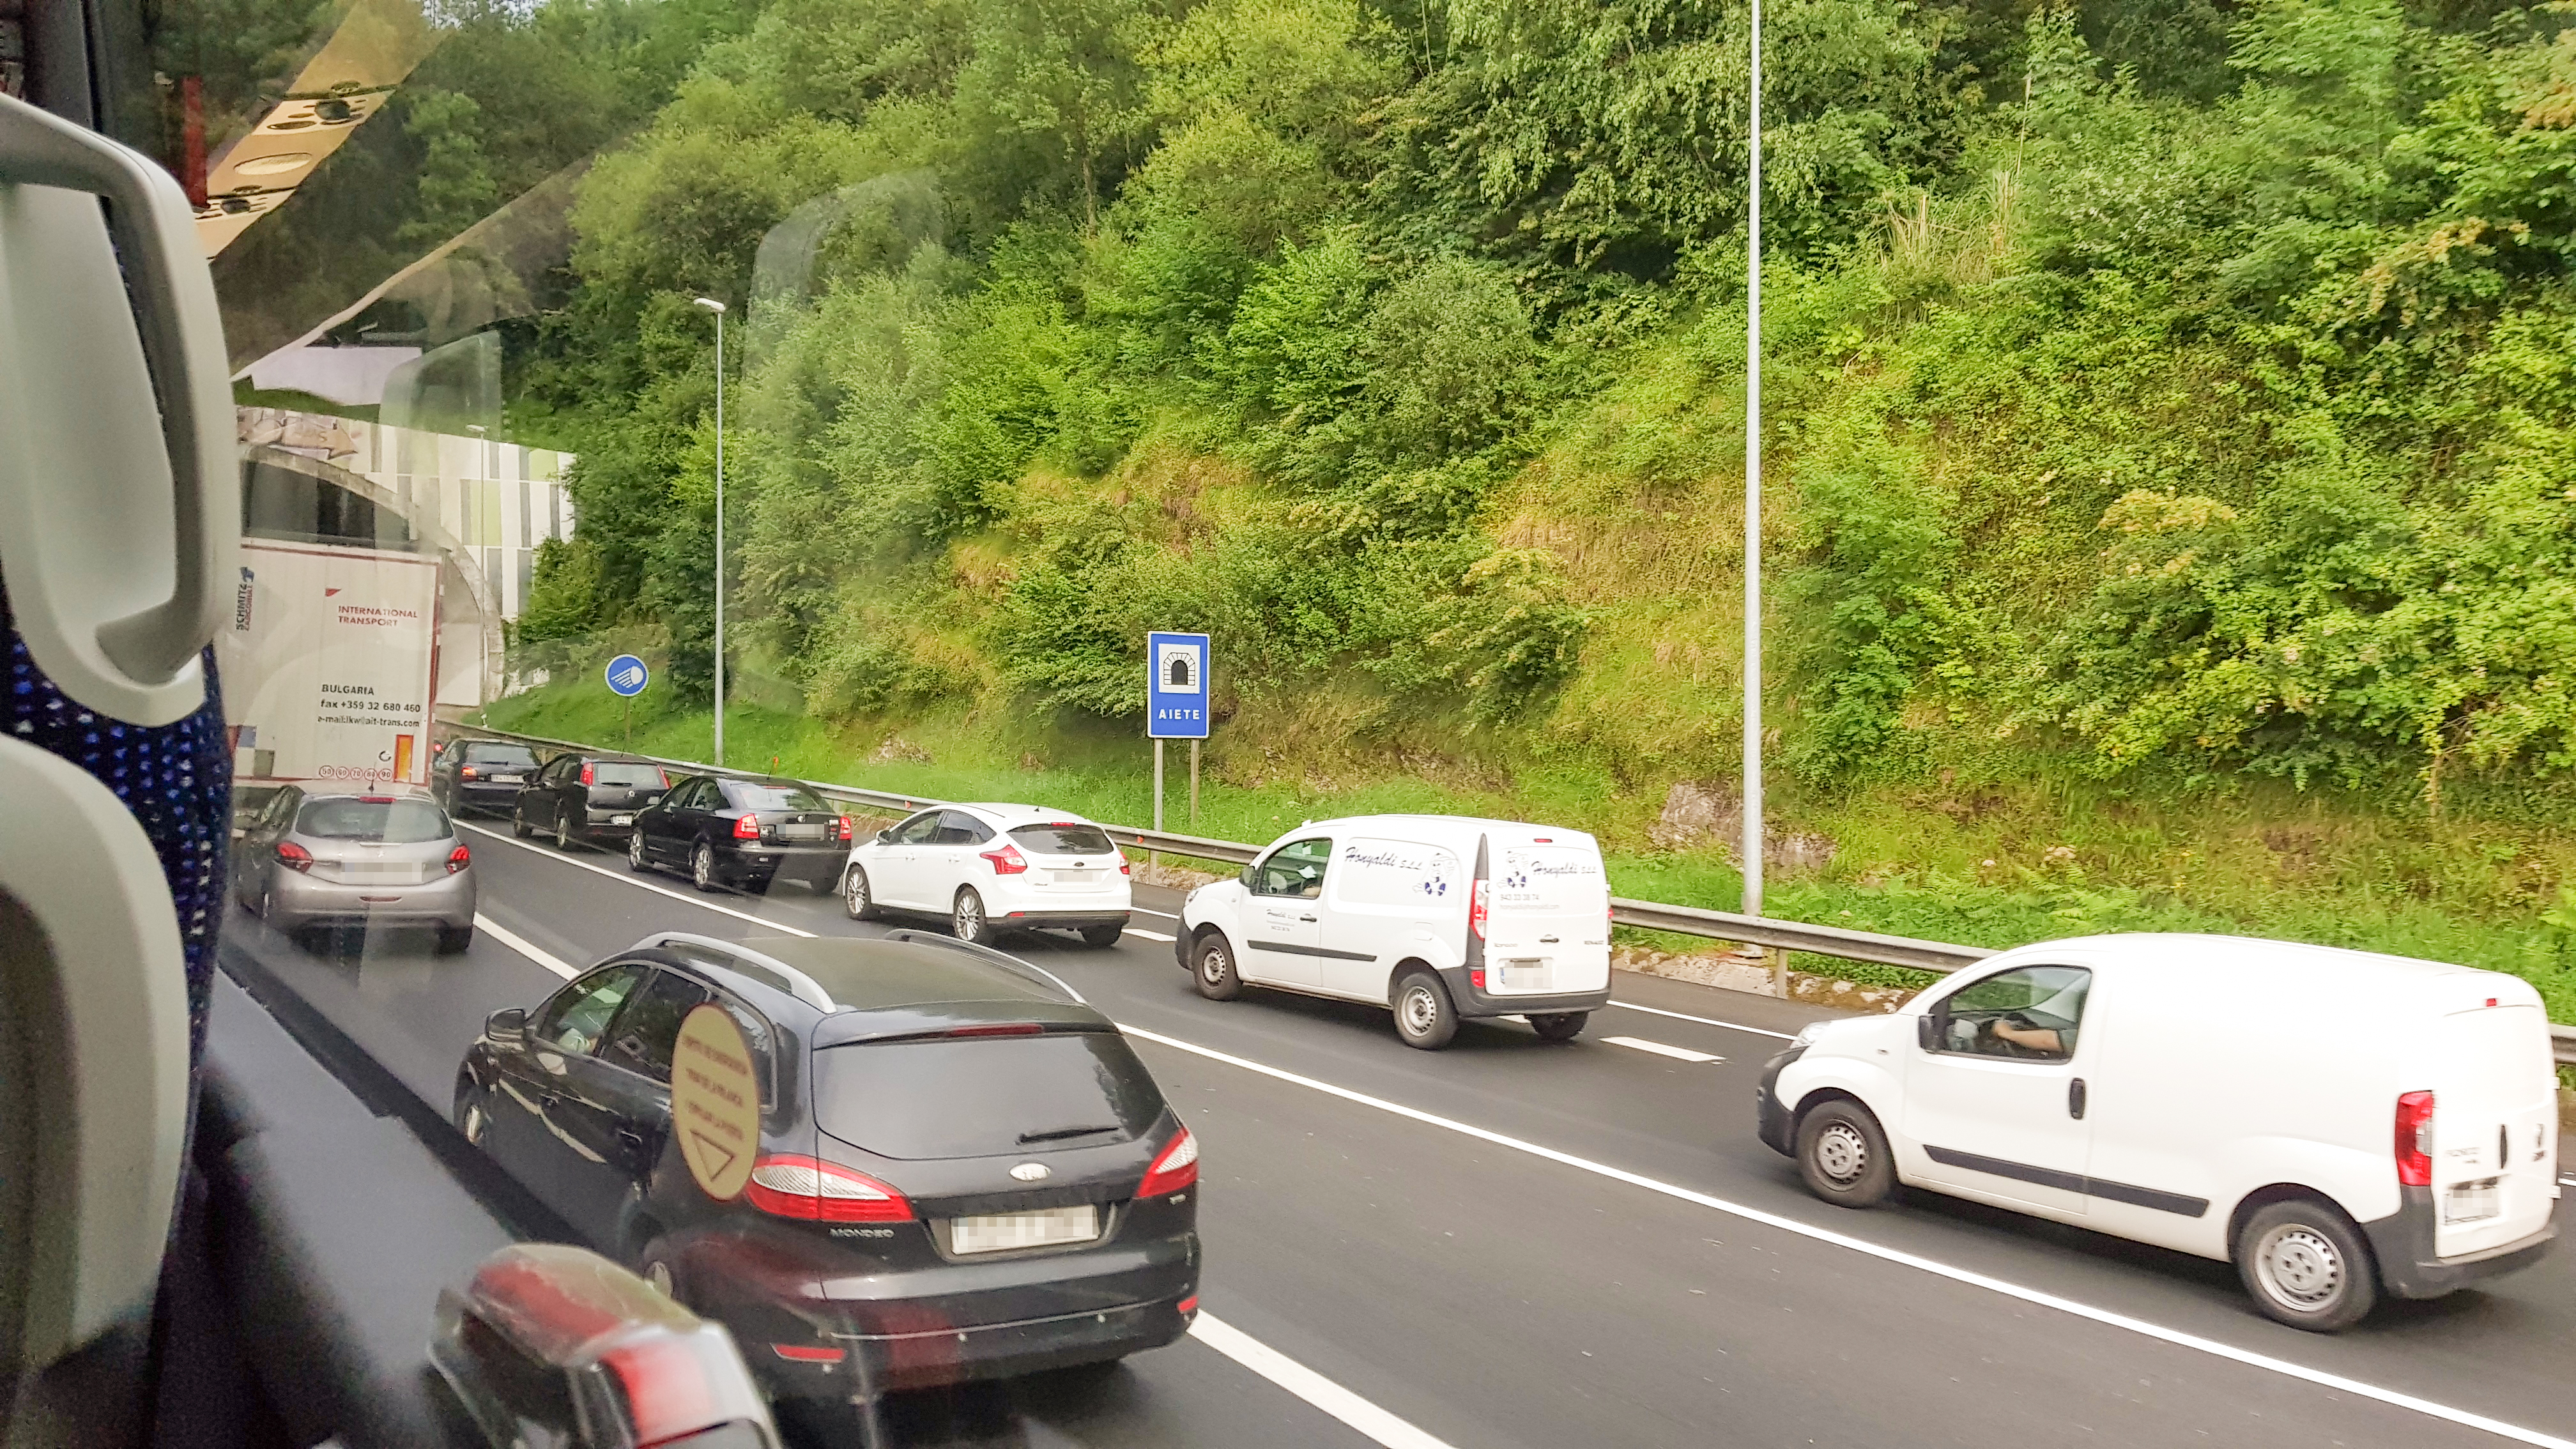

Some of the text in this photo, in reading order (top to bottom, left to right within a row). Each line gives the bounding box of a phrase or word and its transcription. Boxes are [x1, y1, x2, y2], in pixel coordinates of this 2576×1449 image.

[236, 584, 247, 630] SCHMITZ
[338, 606, 418, 618] INTERNATIONAL
[338, 616, 398, 626] TRANSPORT
[321, 684, 374, 695] BULGARIA
[320, 699, 338, 709] fax
[341, 701, 364, 710] +359
[367, 702, 379, 710] 32
[1158, 709, 1200, 720] AIETE
[829, 1228, 894, 1239] MONDEO
